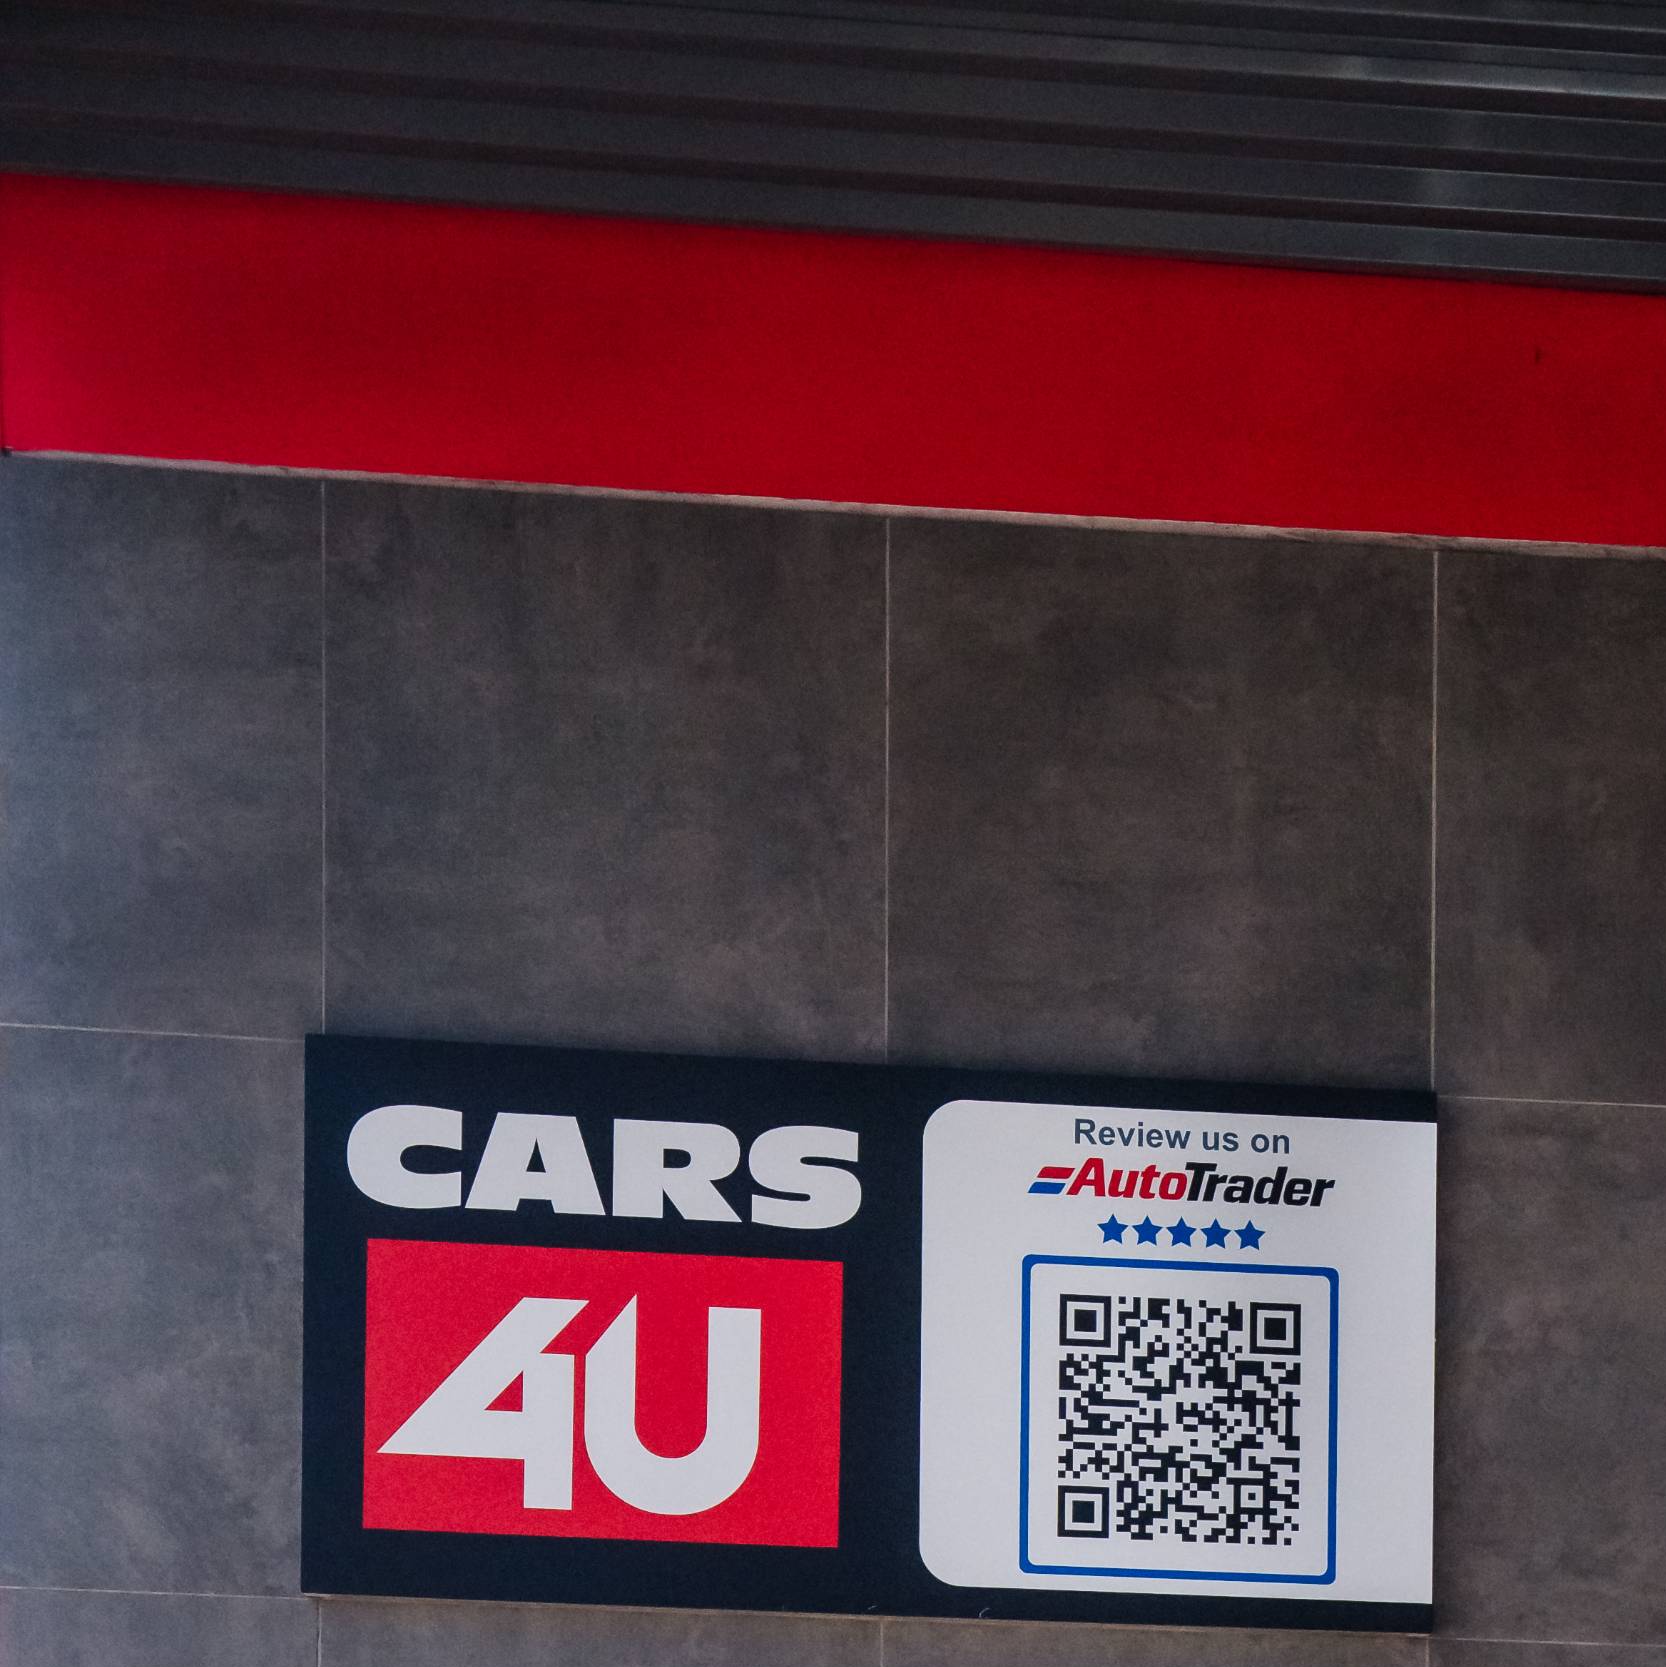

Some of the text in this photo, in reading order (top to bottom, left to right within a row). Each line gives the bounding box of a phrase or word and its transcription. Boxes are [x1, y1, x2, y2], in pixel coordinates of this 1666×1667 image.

[347, 1104, 862, 1229] CARS
[1074, 1118, 1290, 1154] Review us on
[1066, 1157, 1336, 1207] AutoTrader
[377, 1293, 762, 1515] 4U
